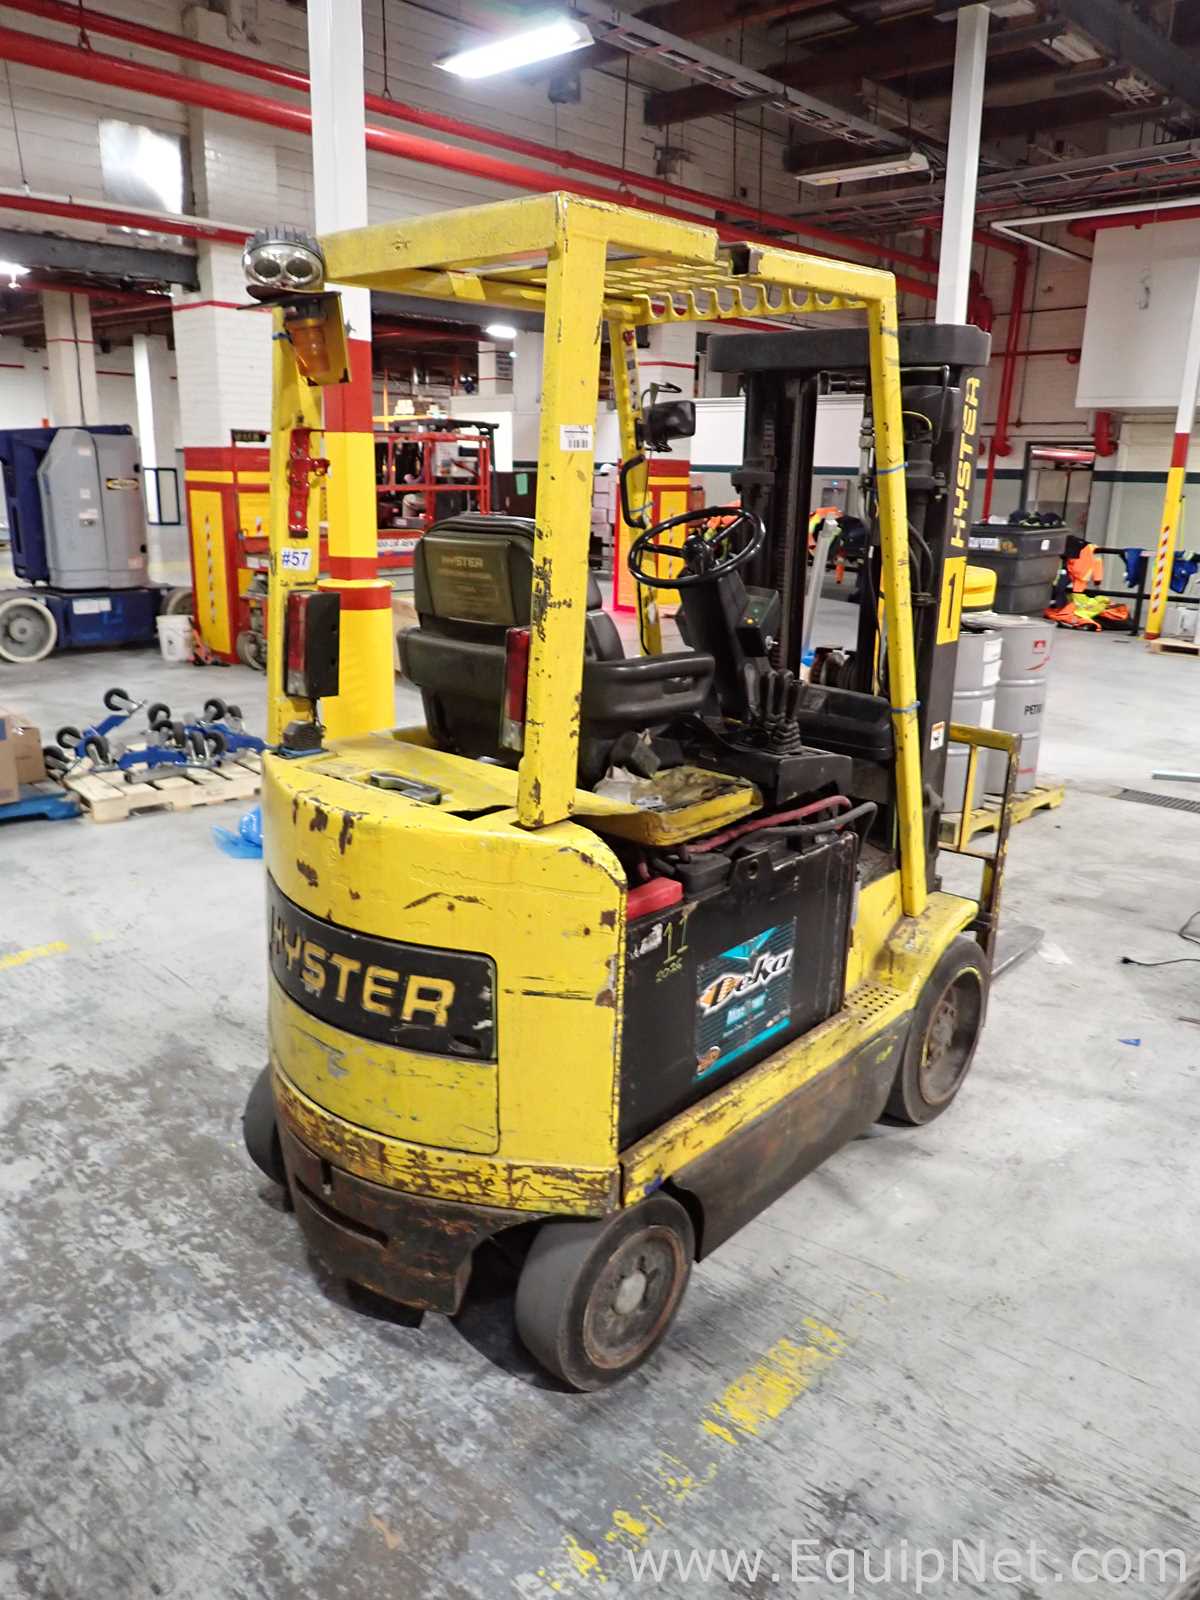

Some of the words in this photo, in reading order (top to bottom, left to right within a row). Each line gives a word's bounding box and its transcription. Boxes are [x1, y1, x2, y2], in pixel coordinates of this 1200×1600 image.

[950, 376, 981, 548] HYSTER
[282, 551, 309, 566] #57
[946, 572, 957, 629] 1
[271, 906, 456, 1028] HYSTER
[699, 949, 793, 1014] Deka
